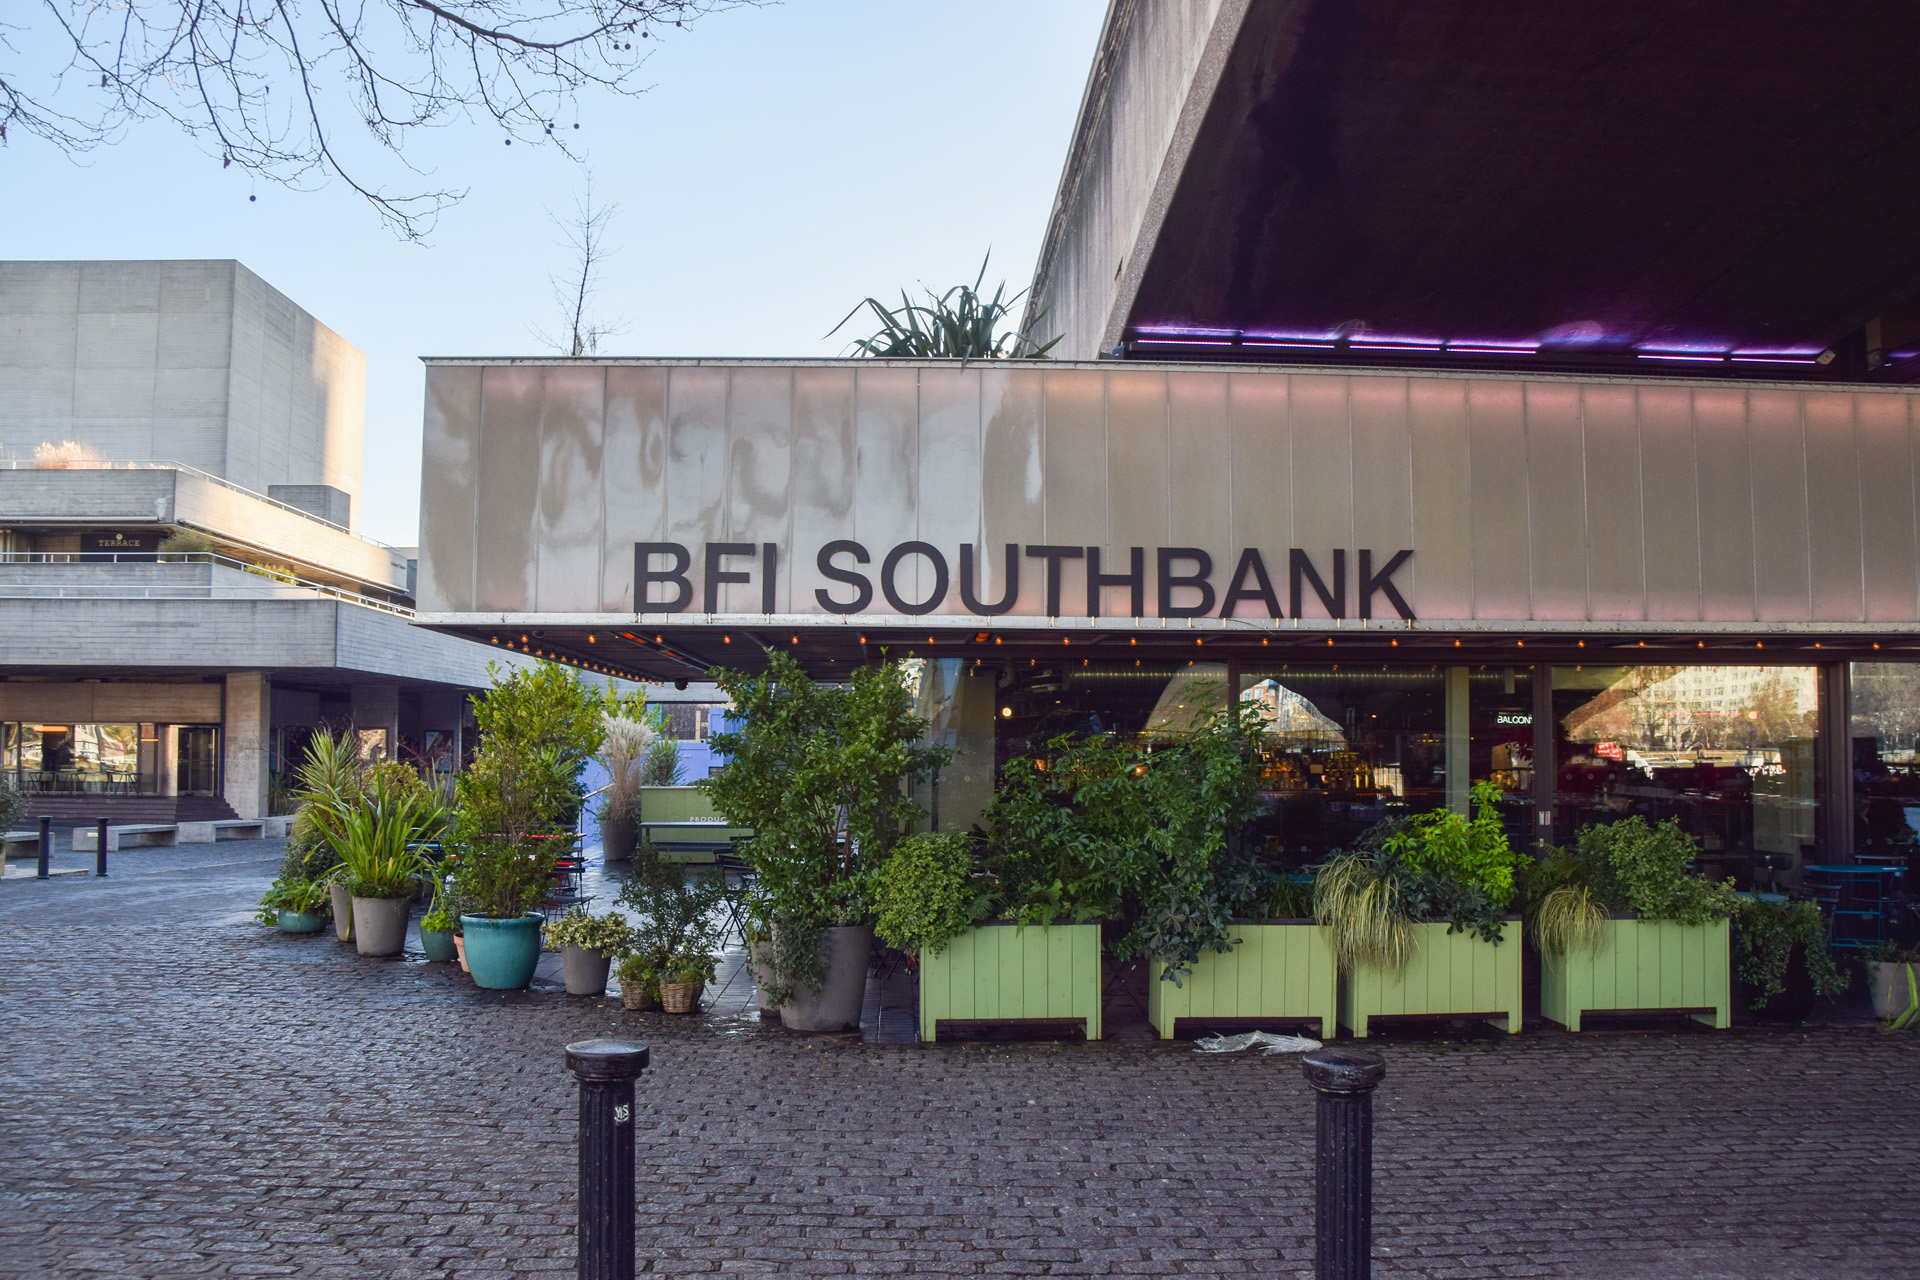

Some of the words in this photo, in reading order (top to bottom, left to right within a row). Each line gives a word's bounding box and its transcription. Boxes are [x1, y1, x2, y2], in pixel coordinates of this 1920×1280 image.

[98, 539, 141, 547] TERRACE
[633, 541, 778, 614] BFI
[814, 539, 1417, 620] SOUTHBANK
